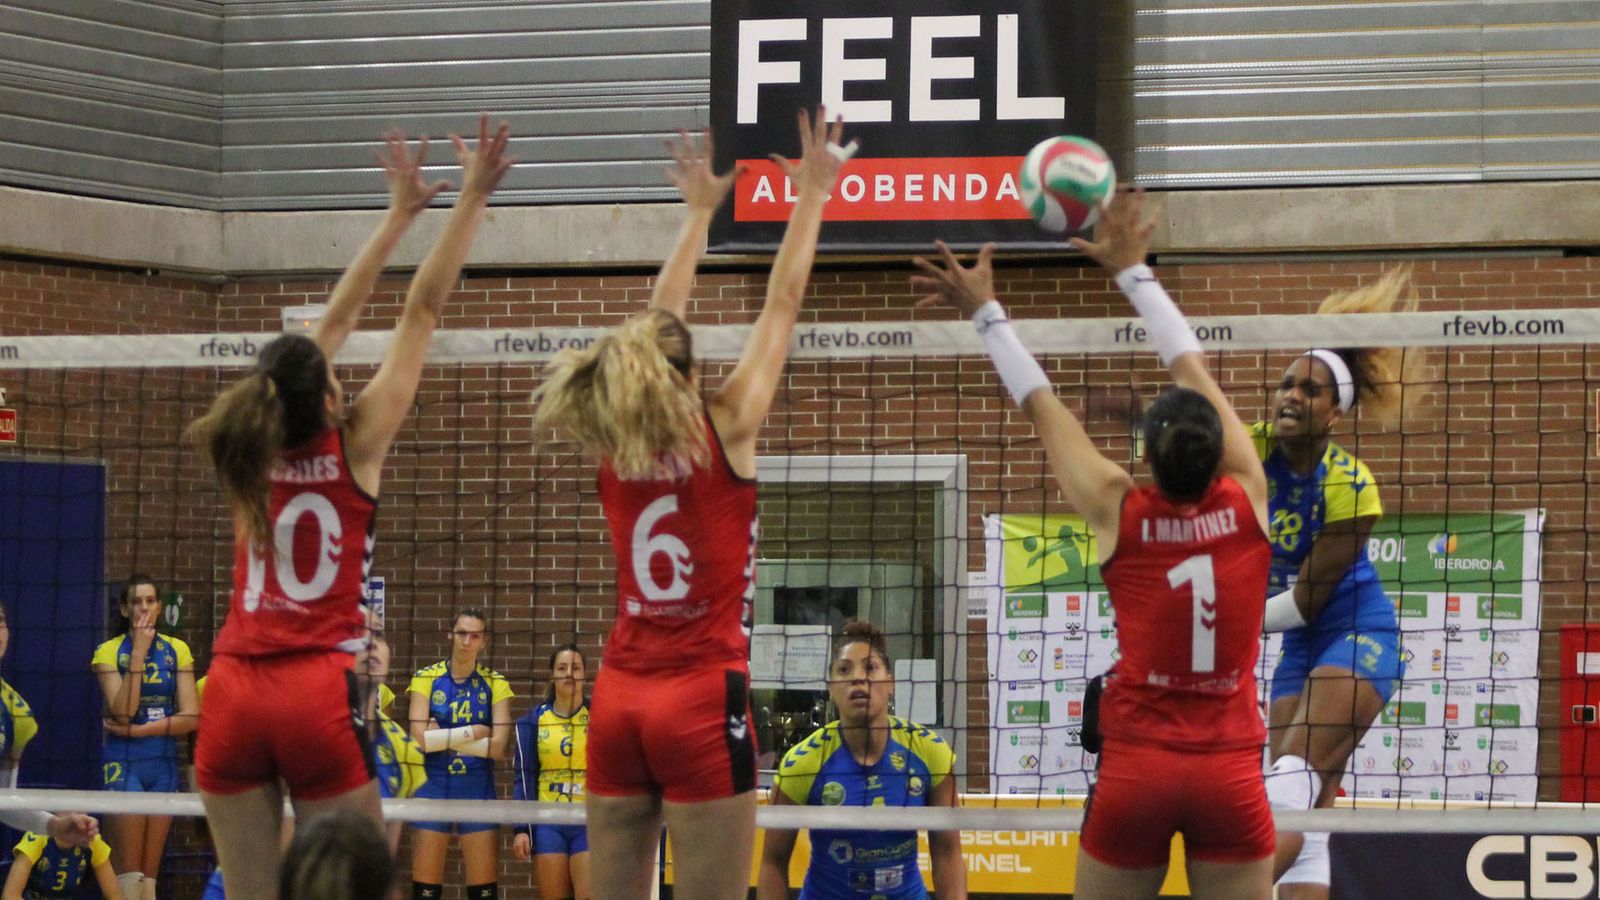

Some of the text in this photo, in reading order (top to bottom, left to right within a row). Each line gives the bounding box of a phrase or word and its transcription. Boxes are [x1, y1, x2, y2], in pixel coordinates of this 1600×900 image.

[737, 14, 1065, 125] FEEL
[751, 173, 1020, 202] ALOBENDA
[1443, 315, 1564, 337] rfevb.com
[800, 329, 912, 348] rfevb.com
[1156, 508, 1238, 542] MARTINEZ
[632, 494, 694, 601] 6
[1434, 558, 1505, 571] IBERDROLA
[1166, 554, 1217, 673] 1
[449, 700, 472, 724] 14
[560, 736, 573, 757] 6
[103, 762, 124, 784] 12
[960, 829, 1081, 846] SECURIT
[1466, 834, 1600, 899] CB
[52, 870, 67, 891] 3
